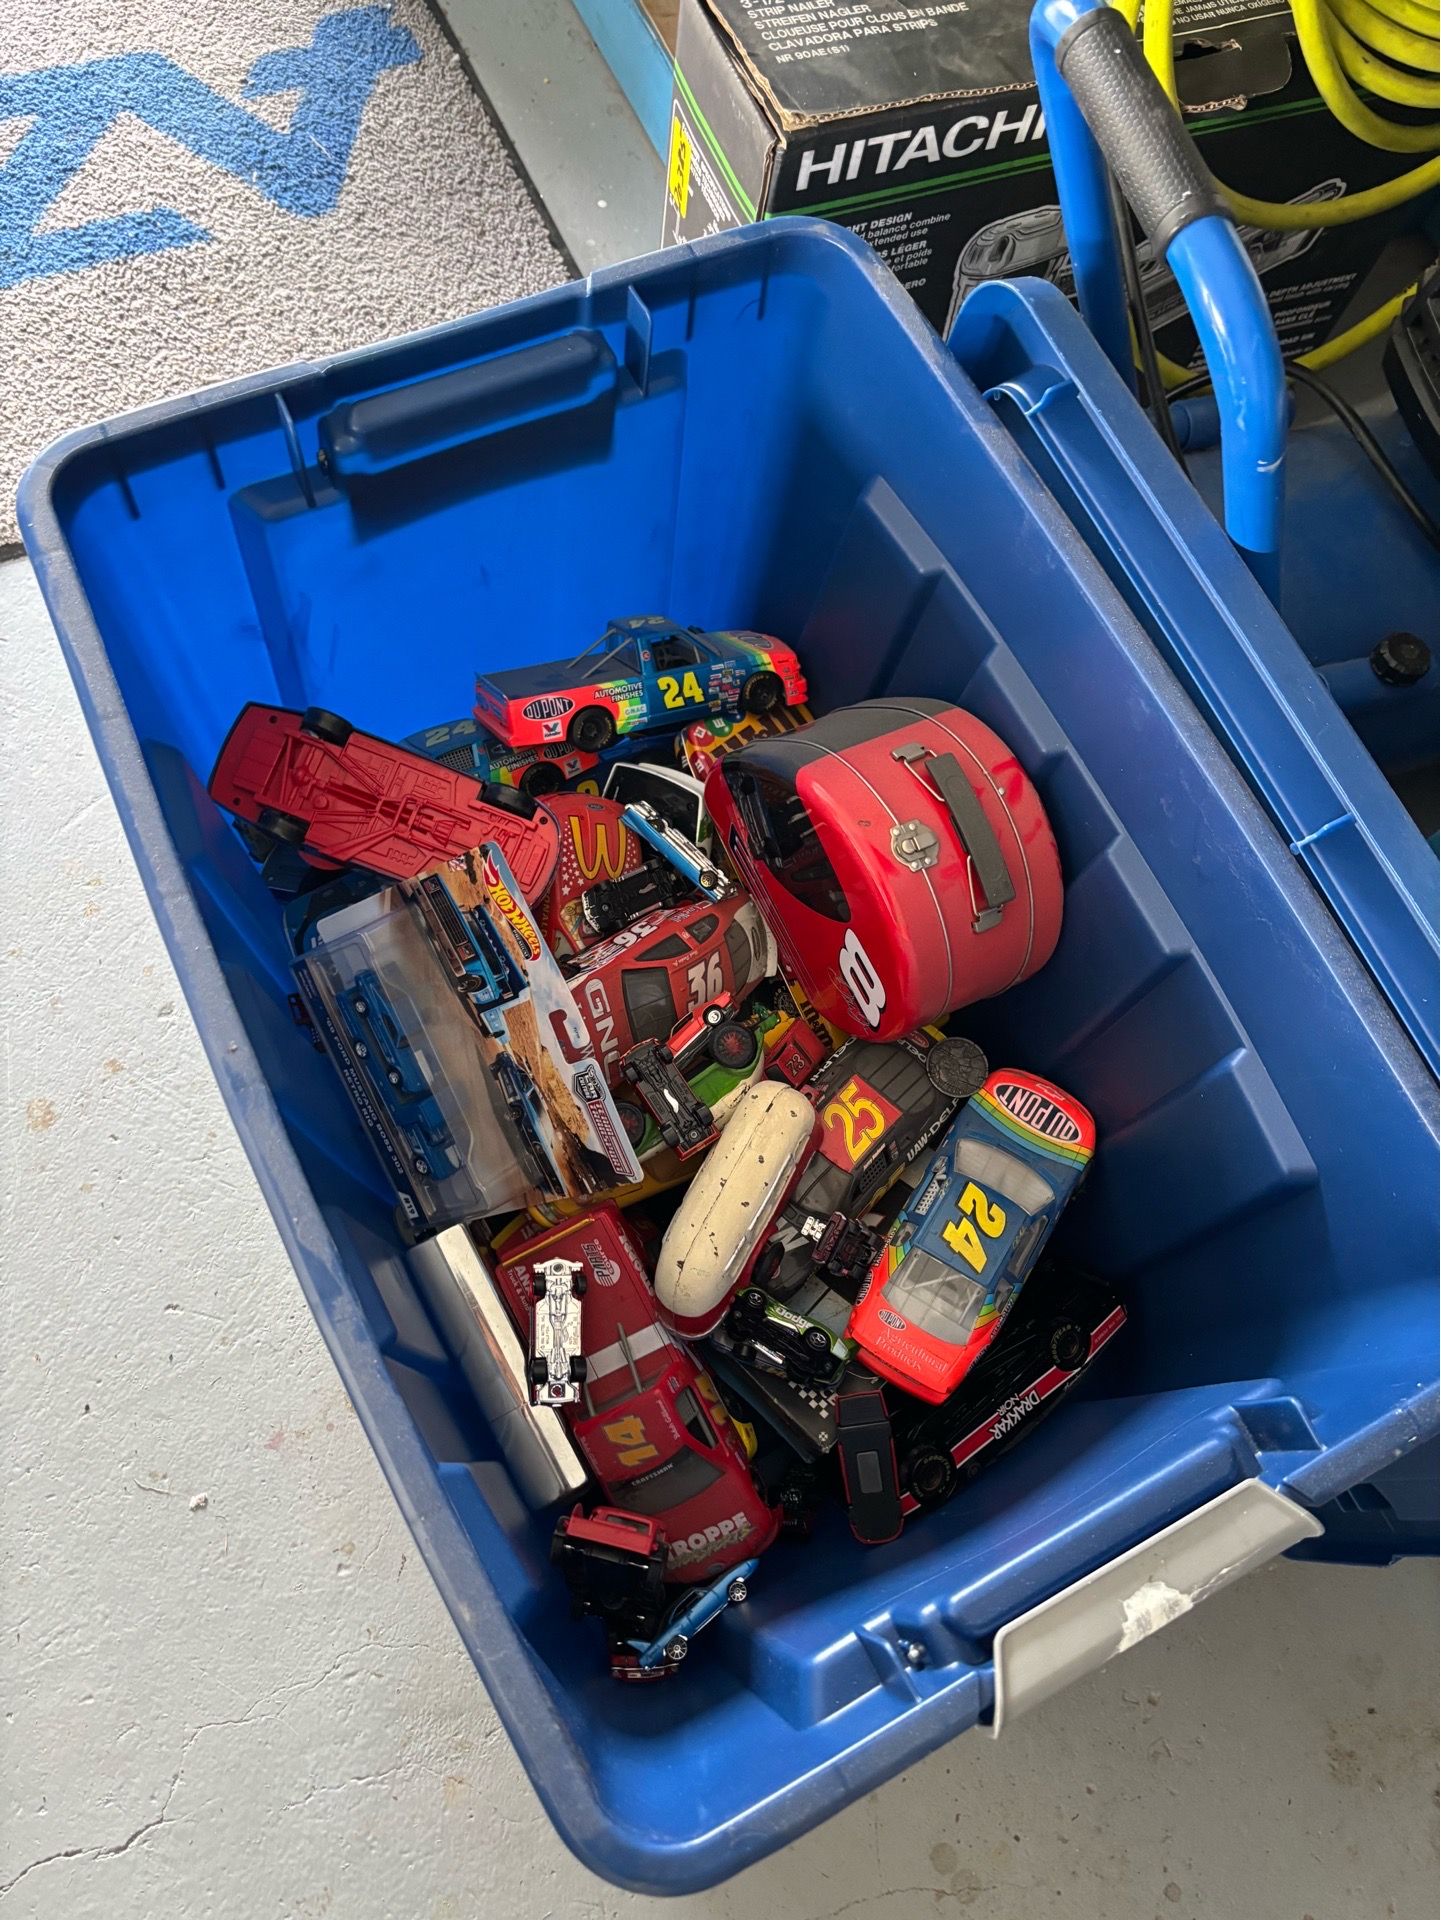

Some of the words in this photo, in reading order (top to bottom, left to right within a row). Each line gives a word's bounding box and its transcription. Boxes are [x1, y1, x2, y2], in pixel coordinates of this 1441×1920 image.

[747, 6, 785, 19] STRIP
[787, 0, 836, 13] NAILER
[754, 14, 817, 30] STREIFEN
[820, 4, 871, 21] NAGLER
[1177, 16, 1190, 25] NO
[1191, 11, 1217, 21] USAR
[1216, 5, 1248, 17] NUNCA
[1185, 1, 1217, 14] JAMAIS
[761, 23, 827, 41] CLOUEUSE
[830, 17, 864, 31] POUR
[866, 11, 904, 26] CLOUS
[906, 7, 925, 18] EN
[926, 2, 969, 17] BANDE
[768, 31, 853, 52] CLAVADORA
[855, 23, 892, 38] PARA
[892, 18, 938, 32] STRIPS
[775, 53, 793, 64] NR
[796, 104, 1046, 191] HITACHI
[868, 224, 907, 239] balance
[910, 213, 951, 228] combine
[870, 212, 912, 228] DESIGN
[911, 228, 928, 237] use
[891, 240, 927, 255] LÉGER
[894, 255, 904, 264] et
[907, 248, 932, 263] poids
[594, 682, 643, 699] AUTOMOTIVE
[611, 691, 643, 702] FINISHES
[657, 671, 705, 709] 24
[425, 720, 476, 747] 24
[687, 951, 723, 1012] 36
[839, 928, 886, 1027] 8
[341, 1068, 364, 1105] RETRO
[332, 1034, 352, 1066] FORD
[347, 1067, 379, 1122] MUSTANG
[374, 1122, 394, 1153] BOSS
[390, 1153, 404, 1175] 302
[823, 1081, 887, 1164] 25
[401, 1195, 416, 1215] #19
[942, 1182, 1008, 1274] 24
[506, 1268, 518, 1288] Truck
[873, 1337, 926, 1370] Products
[878, 1328, 950, 1371] Agricultural
[989, 1389, 1041, 1440] DRAKKAR
[996, 1393, 1020, 1416] NOIR
[603, 1414, 659, 1466] 14
[631, 1463, 674, 1487] CRAFTSMAN
